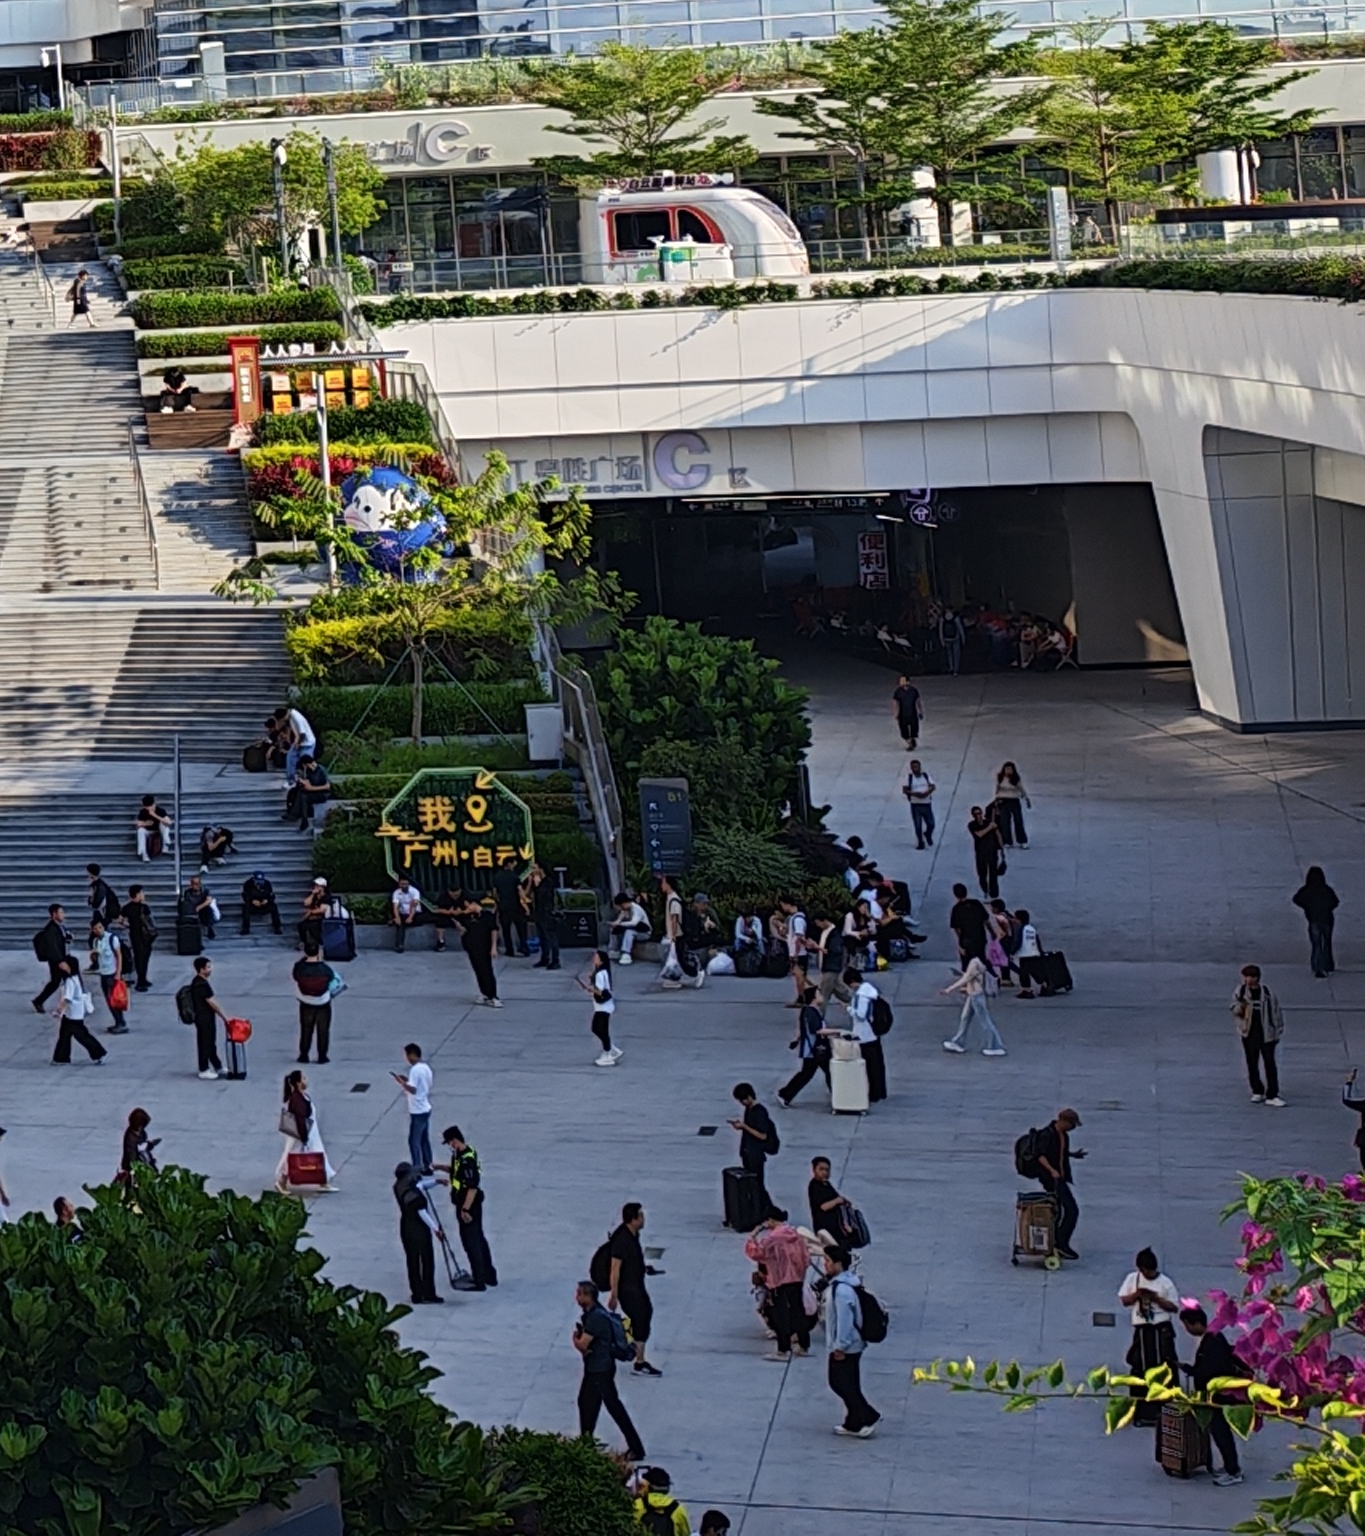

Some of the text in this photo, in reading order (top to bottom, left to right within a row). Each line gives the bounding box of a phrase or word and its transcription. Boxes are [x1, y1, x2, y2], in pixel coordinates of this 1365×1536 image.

[860, 533, 888, 589] 便利店
[418, 795, 457, 833] 我
